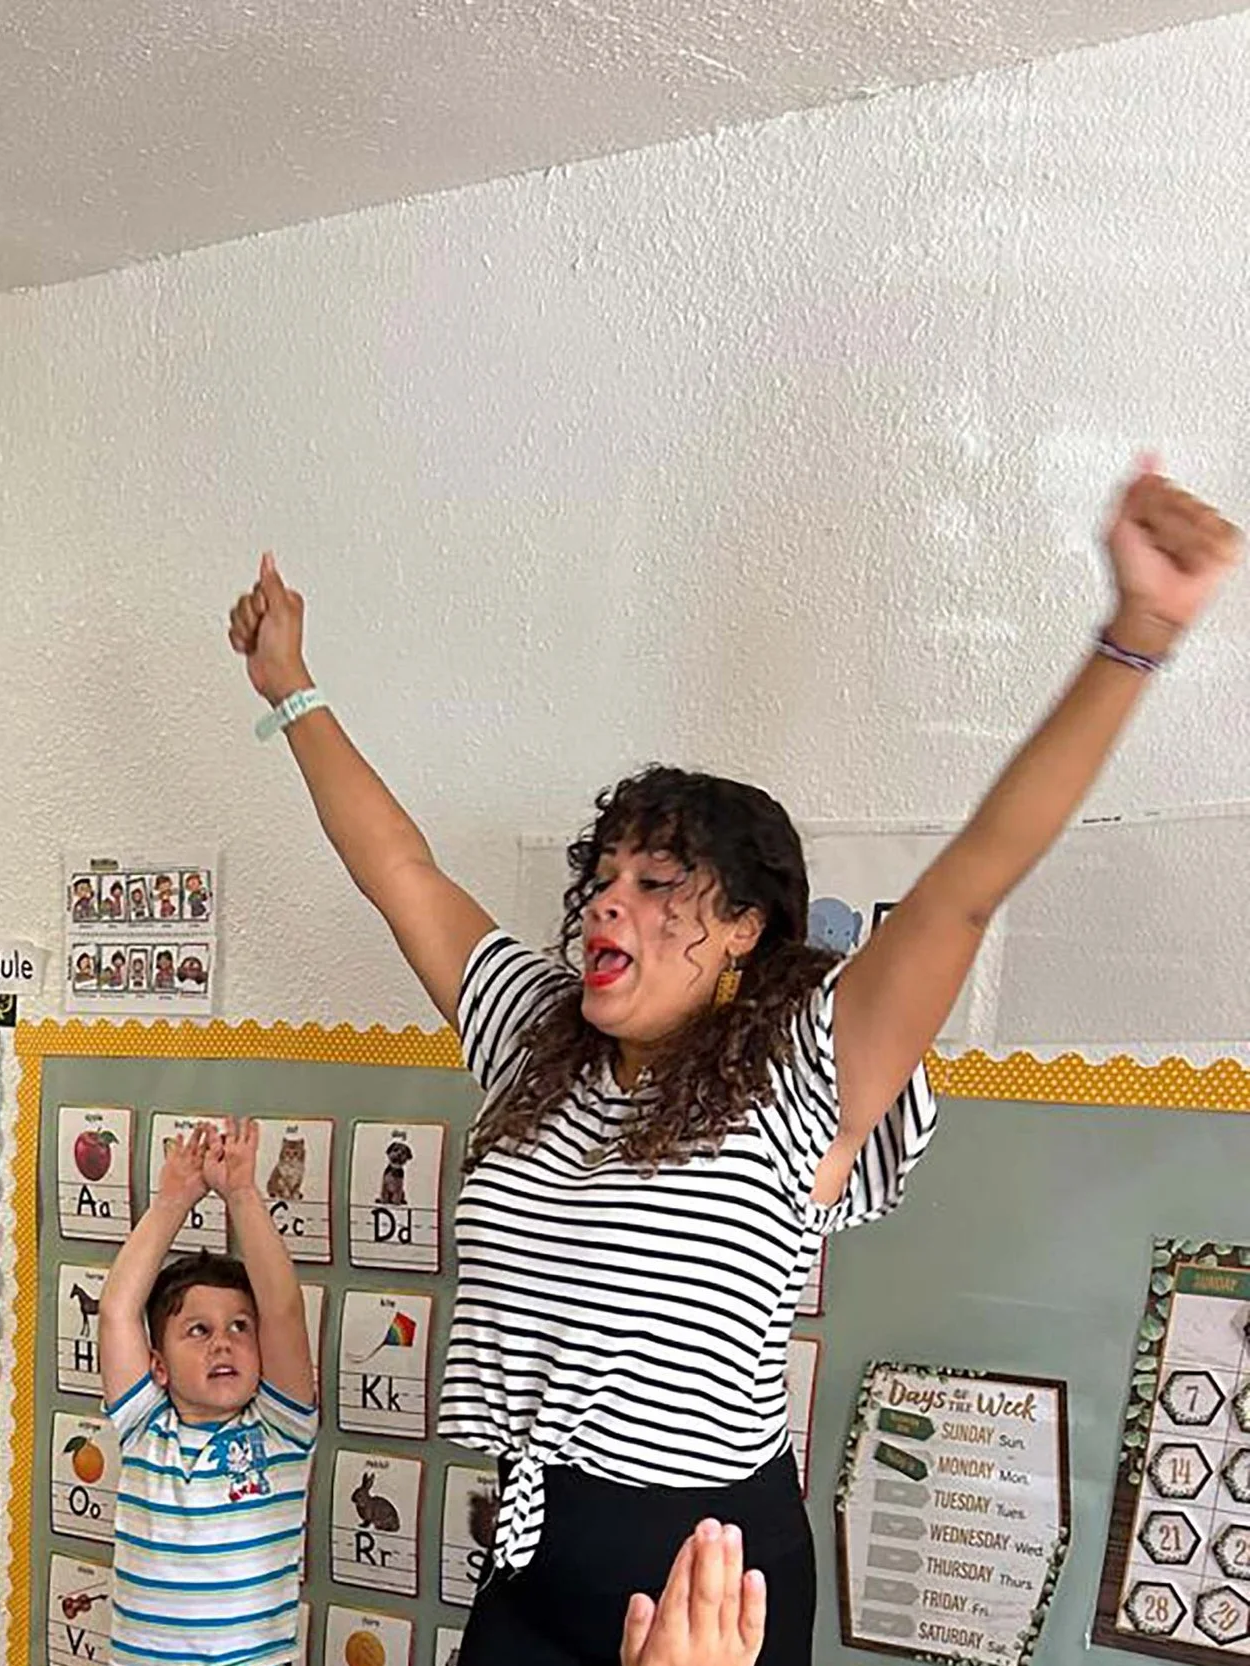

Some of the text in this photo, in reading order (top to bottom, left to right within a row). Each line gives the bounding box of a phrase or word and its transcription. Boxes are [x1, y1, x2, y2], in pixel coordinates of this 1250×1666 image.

[76, 1184, 111, 1218] Aa
[269, 1201, 305, 1236] Cc
[371, 1206, 413, 1245] Dd
[361, 1373, 402, 1412] Kk
[888, 1379, 948, 1414] Days
[976, 1391, 1038, 1423] Week
[1185, 1385, 1199, 1412] 7
[940, 1421, 995, 1446] SUNDAY
[937, 1456, 996, 1480] MONDAY
[1171, 1458, 1191, 1485] 14
[69, 1485, 101, 1520] Oo
[933, 1489, 993, 1514] TUESDAY
[355, 1530, 394, 1568] Rr
[930, 1523, 1011, 1551] WEDNESDAY
[1158, 1524, 1182, 1552] 21
[466, 1550, 488, 1583] S
[926, 1556, 996, 1583] THURSDAY
[922, 1588, 968, 1613] FRIDAY
[1144, 1594, 1169, 1623] 28
[66, 1624, 95, 1662] Vv
[917, 1621, 985, 1650] SATURDAY
